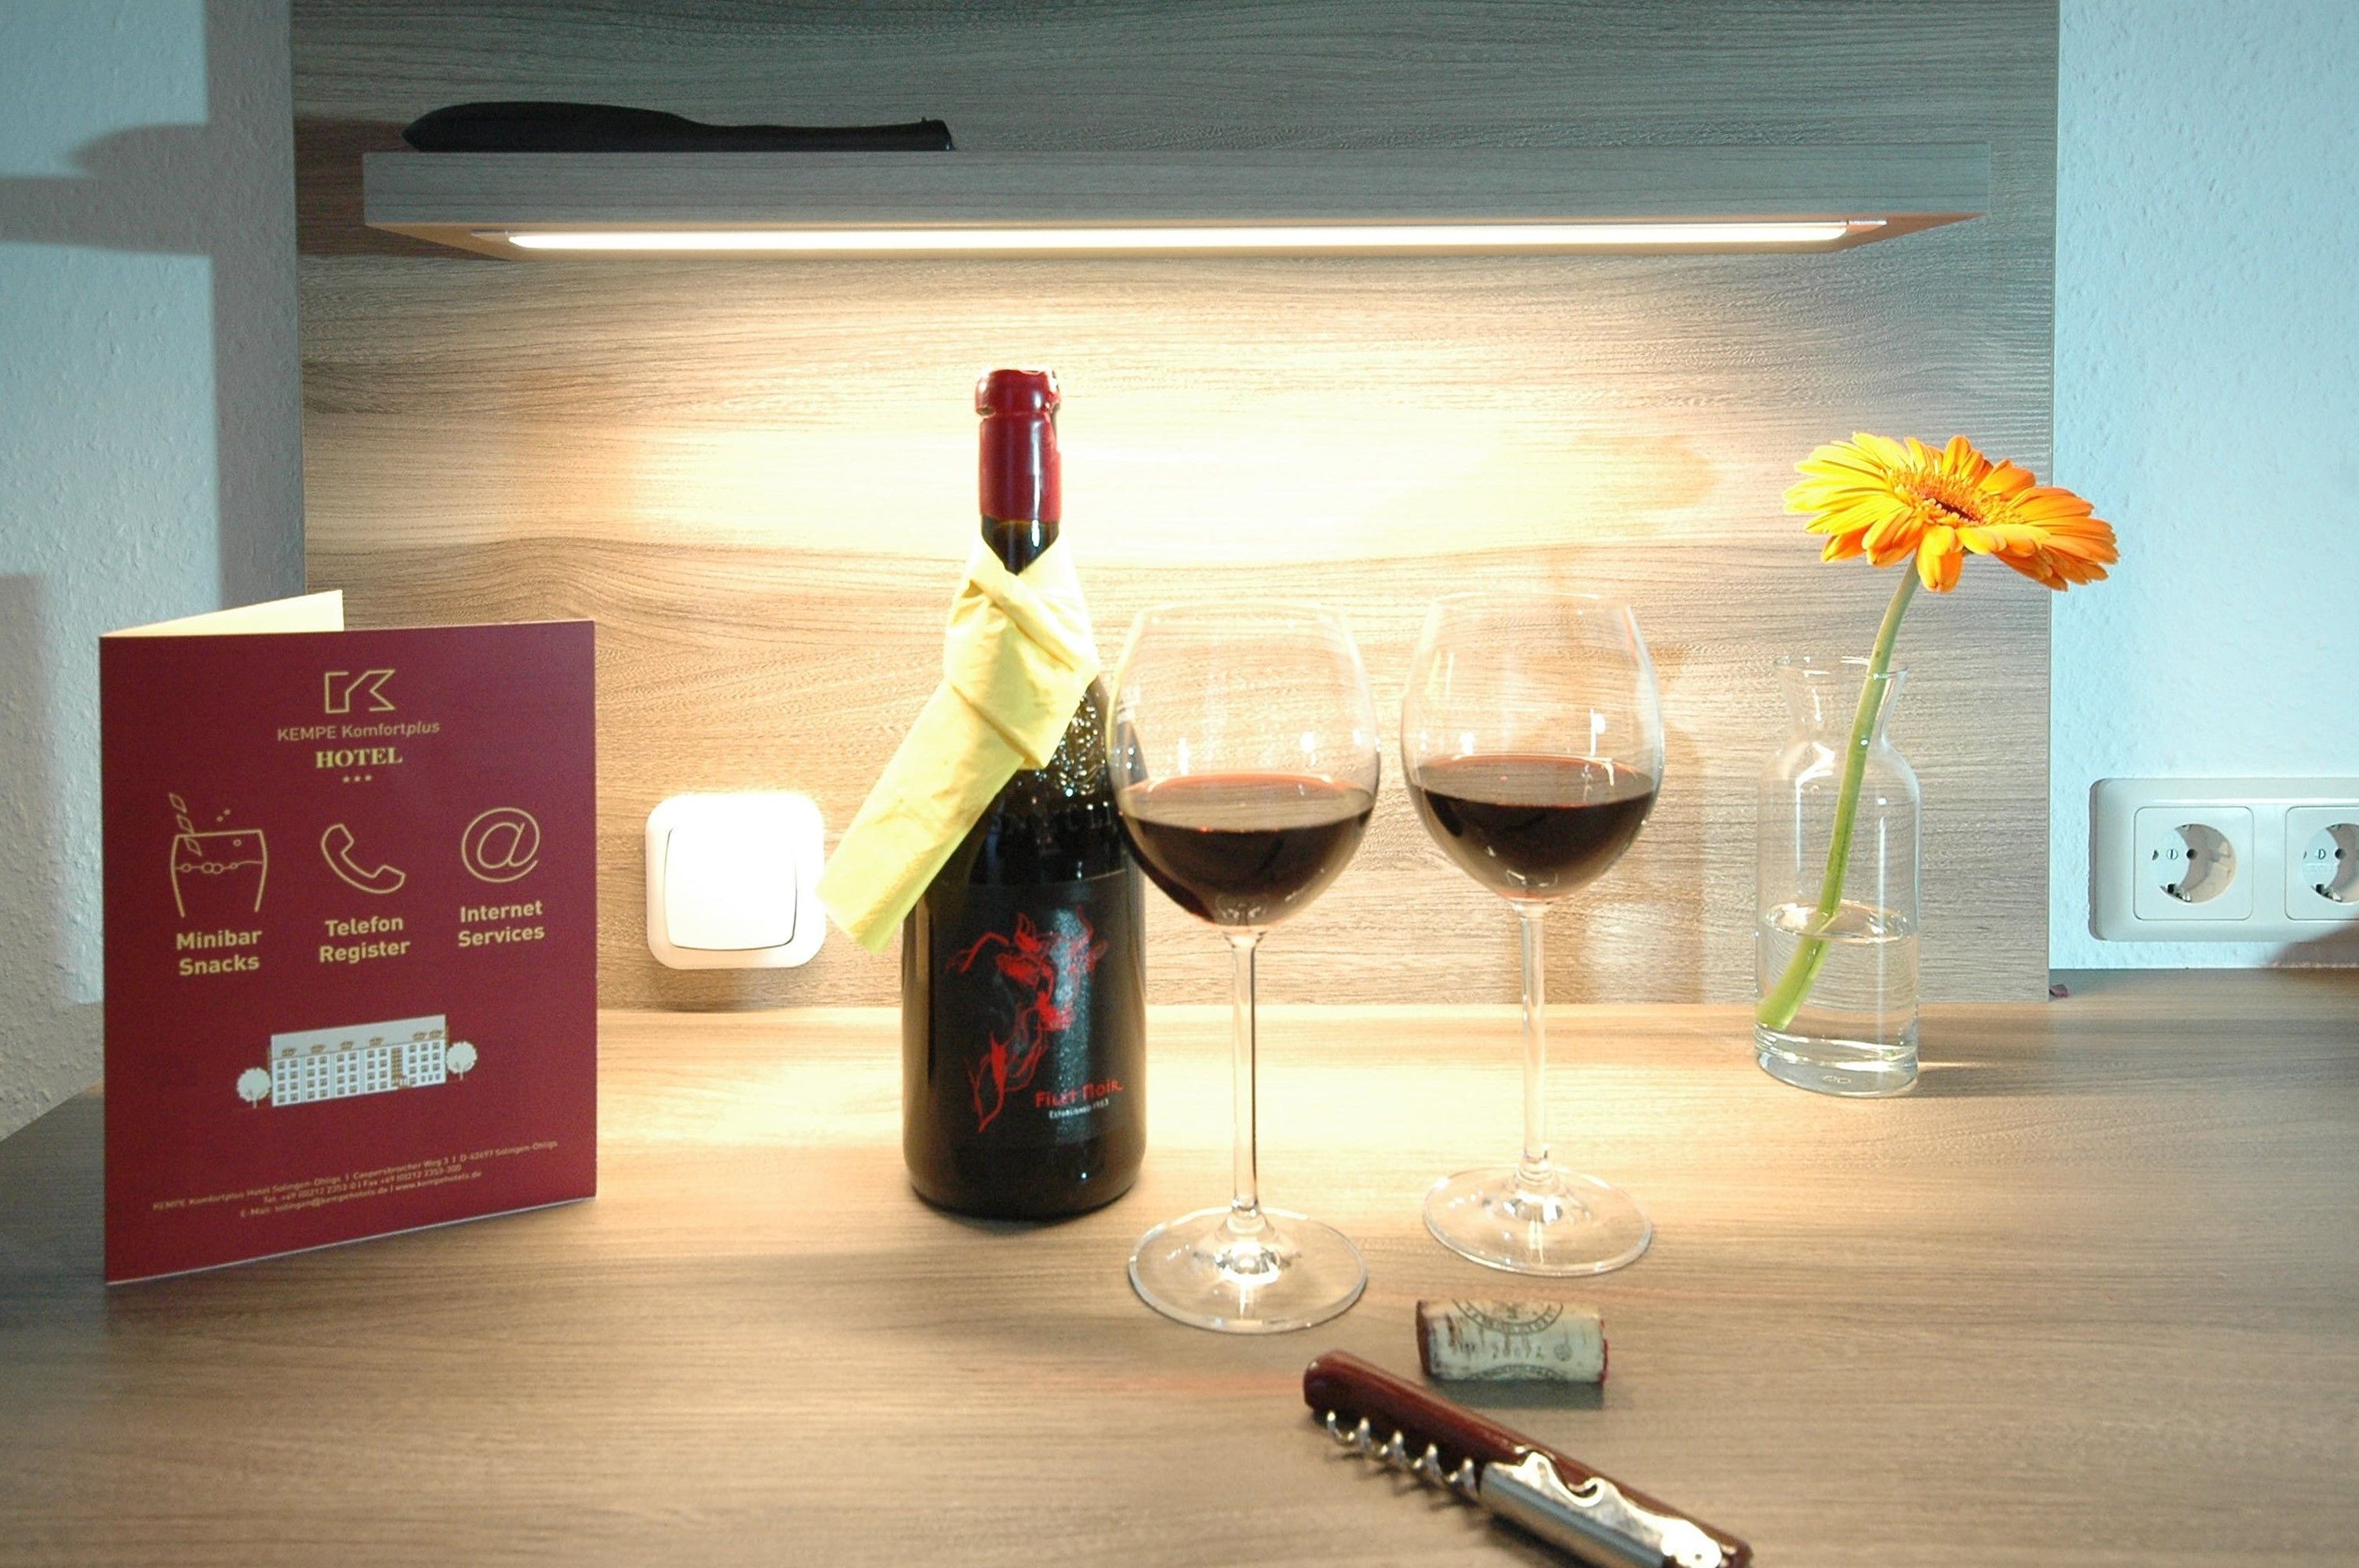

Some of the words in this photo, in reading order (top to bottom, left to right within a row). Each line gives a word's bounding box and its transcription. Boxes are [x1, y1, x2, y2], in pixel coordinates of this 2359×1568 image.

[277, 725, 337, 741] KEMPE
[343, 720, 441, 738] Komfortplus
[316, 747, 403, 768] HOTEL
[460, 900, 543, 923] Internet
[325, 916, 404, 938] Telefon
[458, 926, 545, 947] Services
[176, 929, 263, 950] Minibar
[319, 941, 411, 964] Register
[179, 955, 260, 976] Snacks
